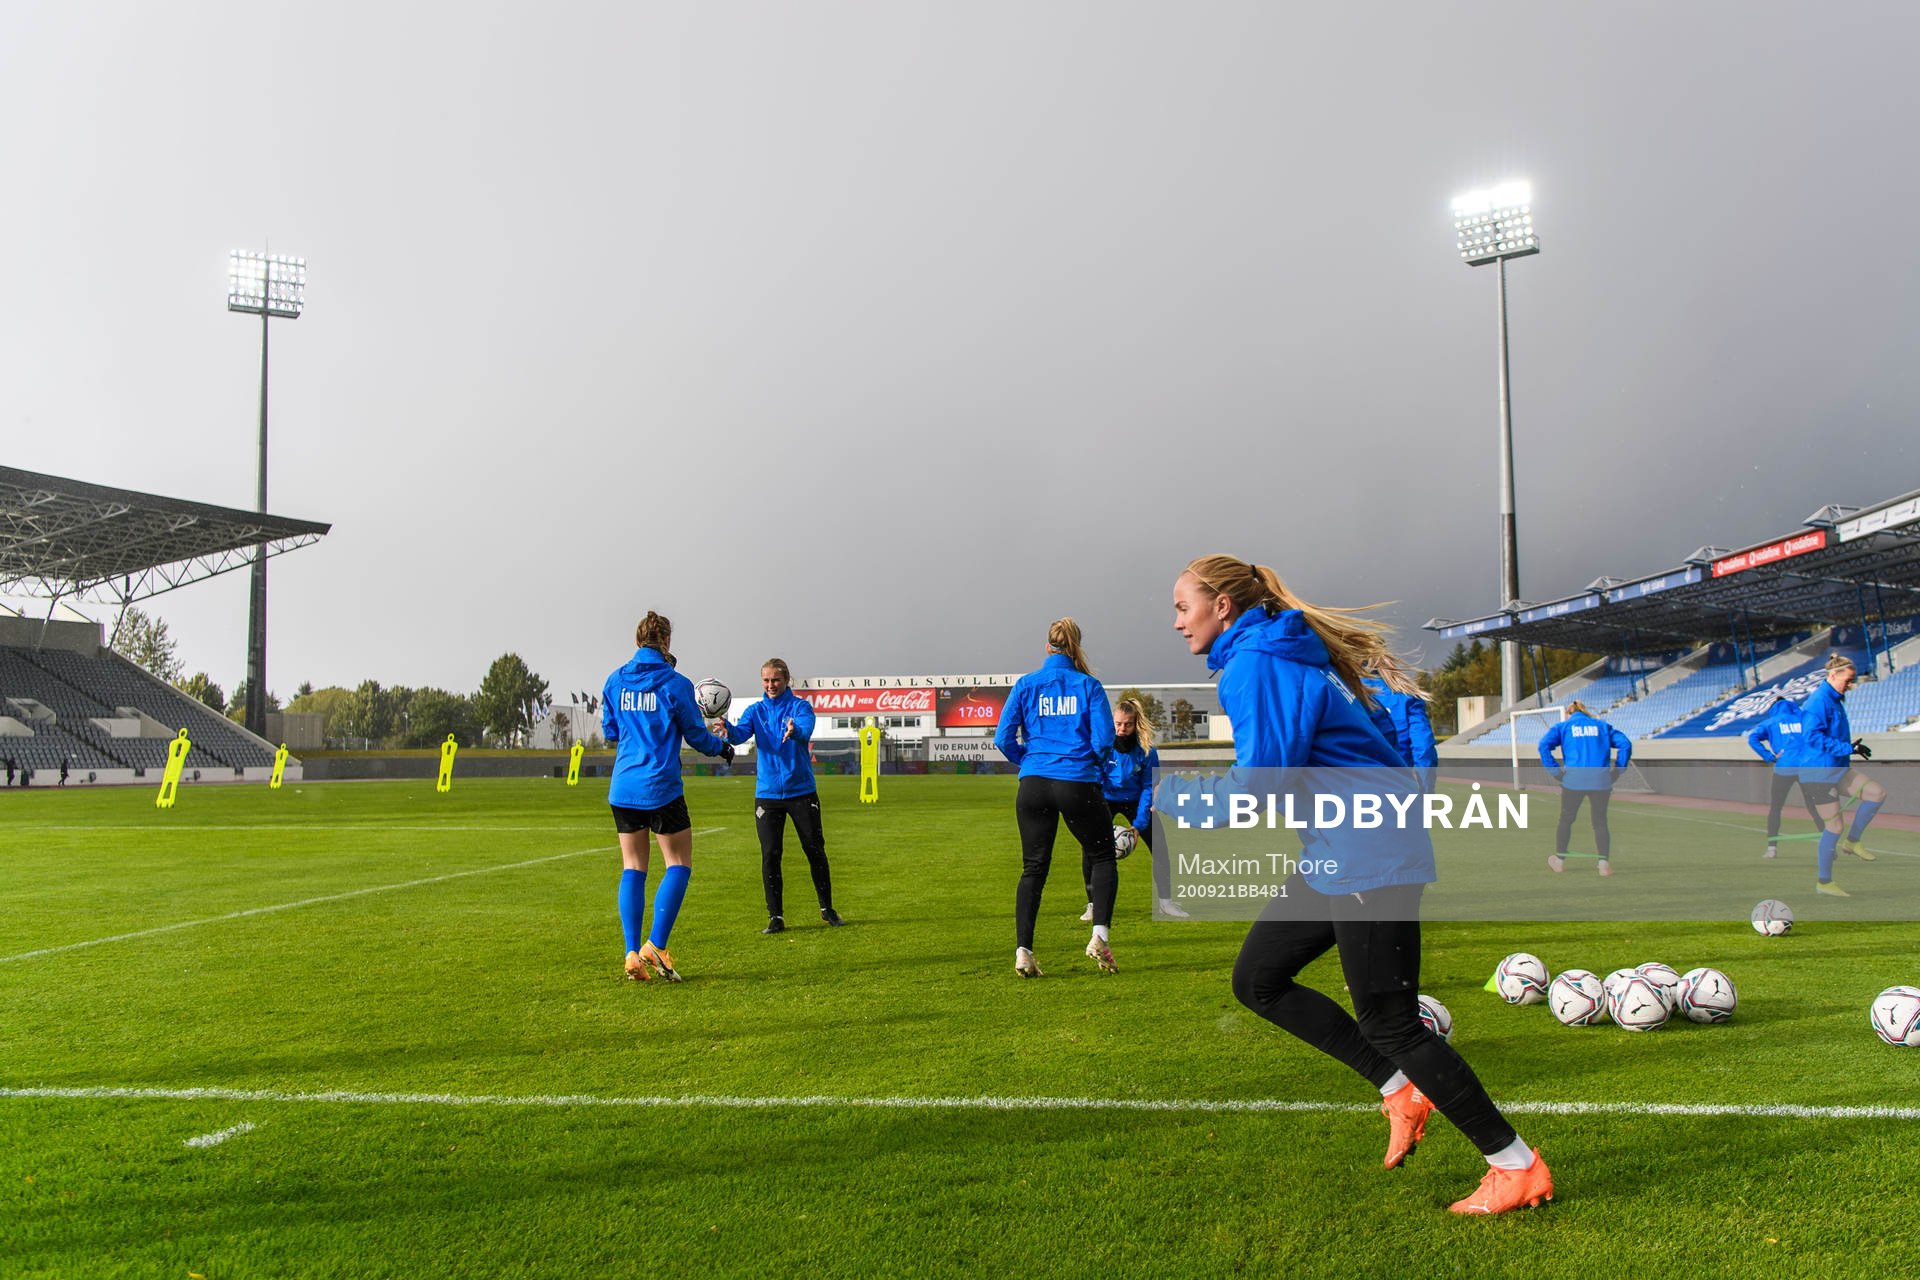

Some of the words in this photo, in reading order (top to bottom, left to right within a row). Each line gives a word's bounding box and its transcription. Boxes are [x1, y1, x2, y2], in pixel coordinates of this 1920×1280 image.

[620, 687, 657, 712] ÍSLAND
[797, 694, 857, 709] AMAN
[1039, 693, 1077, 717] ÍSLAND
[959, 706, 993, 719] 17:08
[951, 743, 979, 751] ERUM
[939, 753, 966, 761] SAMA
